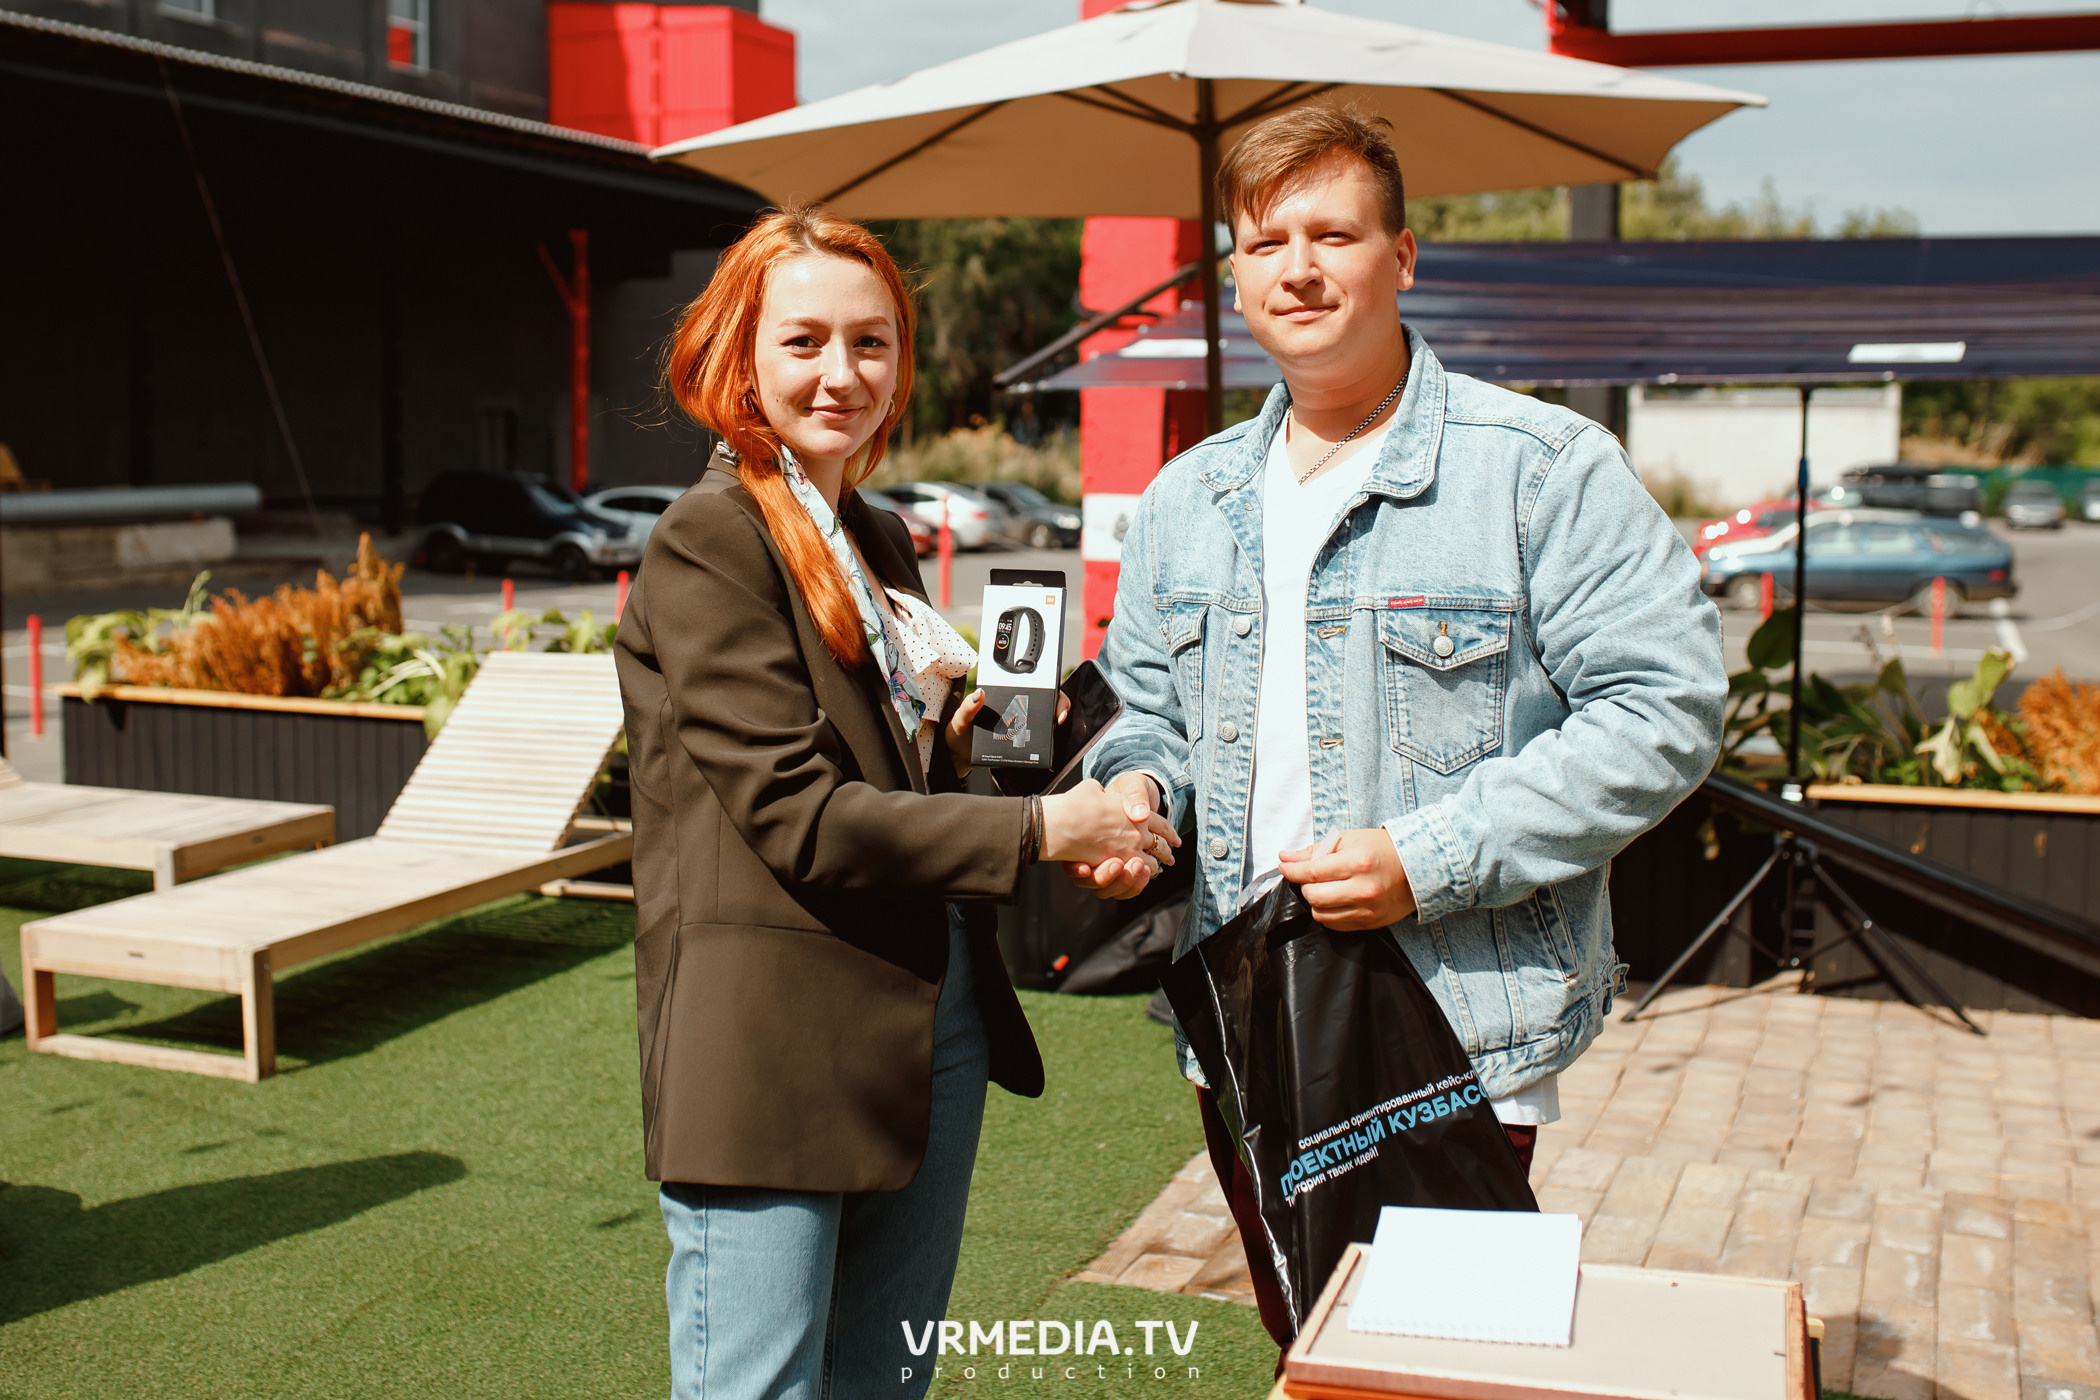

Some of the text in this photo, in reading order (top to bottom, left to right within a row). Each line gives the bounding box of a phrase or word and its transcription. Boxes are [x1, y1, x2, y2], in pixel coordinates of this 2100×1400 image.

[992, 694, 1031, 748] 4
[1298, 1120, 1350, 1150] социально
[1350, 1082, 1436, 1127] ориентированный
[1280, 1116, 1386, 1197] ПОЕКТНЫЙ
[1326, 1159, 1354, 1180] твоих
[1353, 1144, 1379, 1167] идей!
